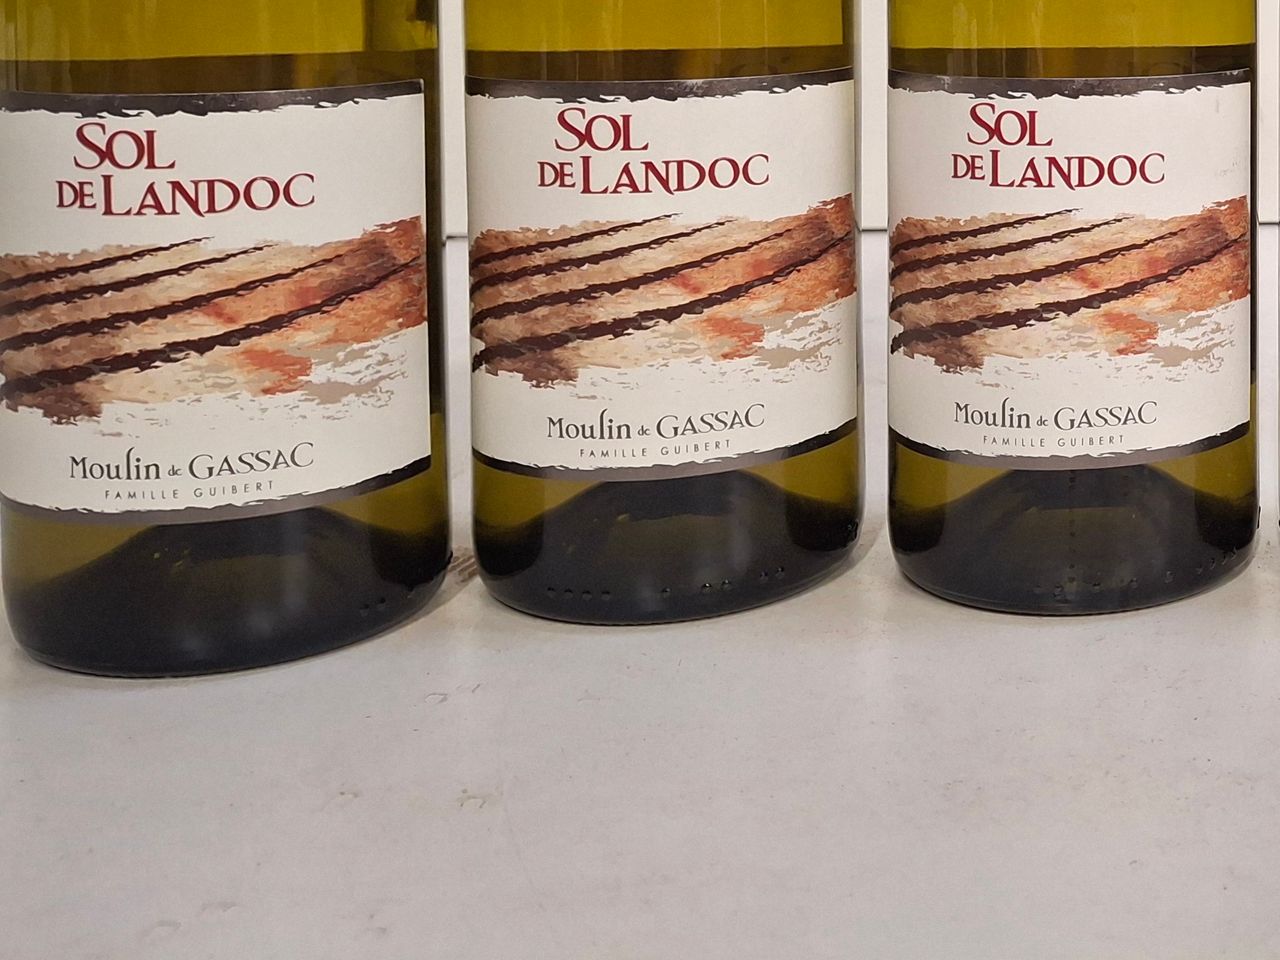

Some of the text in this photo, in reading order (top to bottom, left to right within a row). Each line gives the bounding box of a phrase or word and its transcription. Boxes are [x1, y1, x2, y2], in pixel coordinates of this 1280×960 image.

[554, 107, 649, 152] SOL
[967, 102, 1053, 147] SOL
[73, 122, 175, 170] SOL
[538, 154, 770, 194] DE LANDOC
[952, 150, 1165, 191] DE LANDOC
[56, 173, 315, 217] DE LANDOC
[547, 403, 765, 440] Moulin de GASSAC
[954, 397, 1158, 431] Moulin de GASSAC
[69, 441, 314, 481] Moulin de GASSAC
[580, 439, 732, 458] FAMILLE GUIBERT
[983, 435, 1124, 447] FAMILLE GUIBERT
[105, 480, 275, 500] FAMILLE GUIBERT
